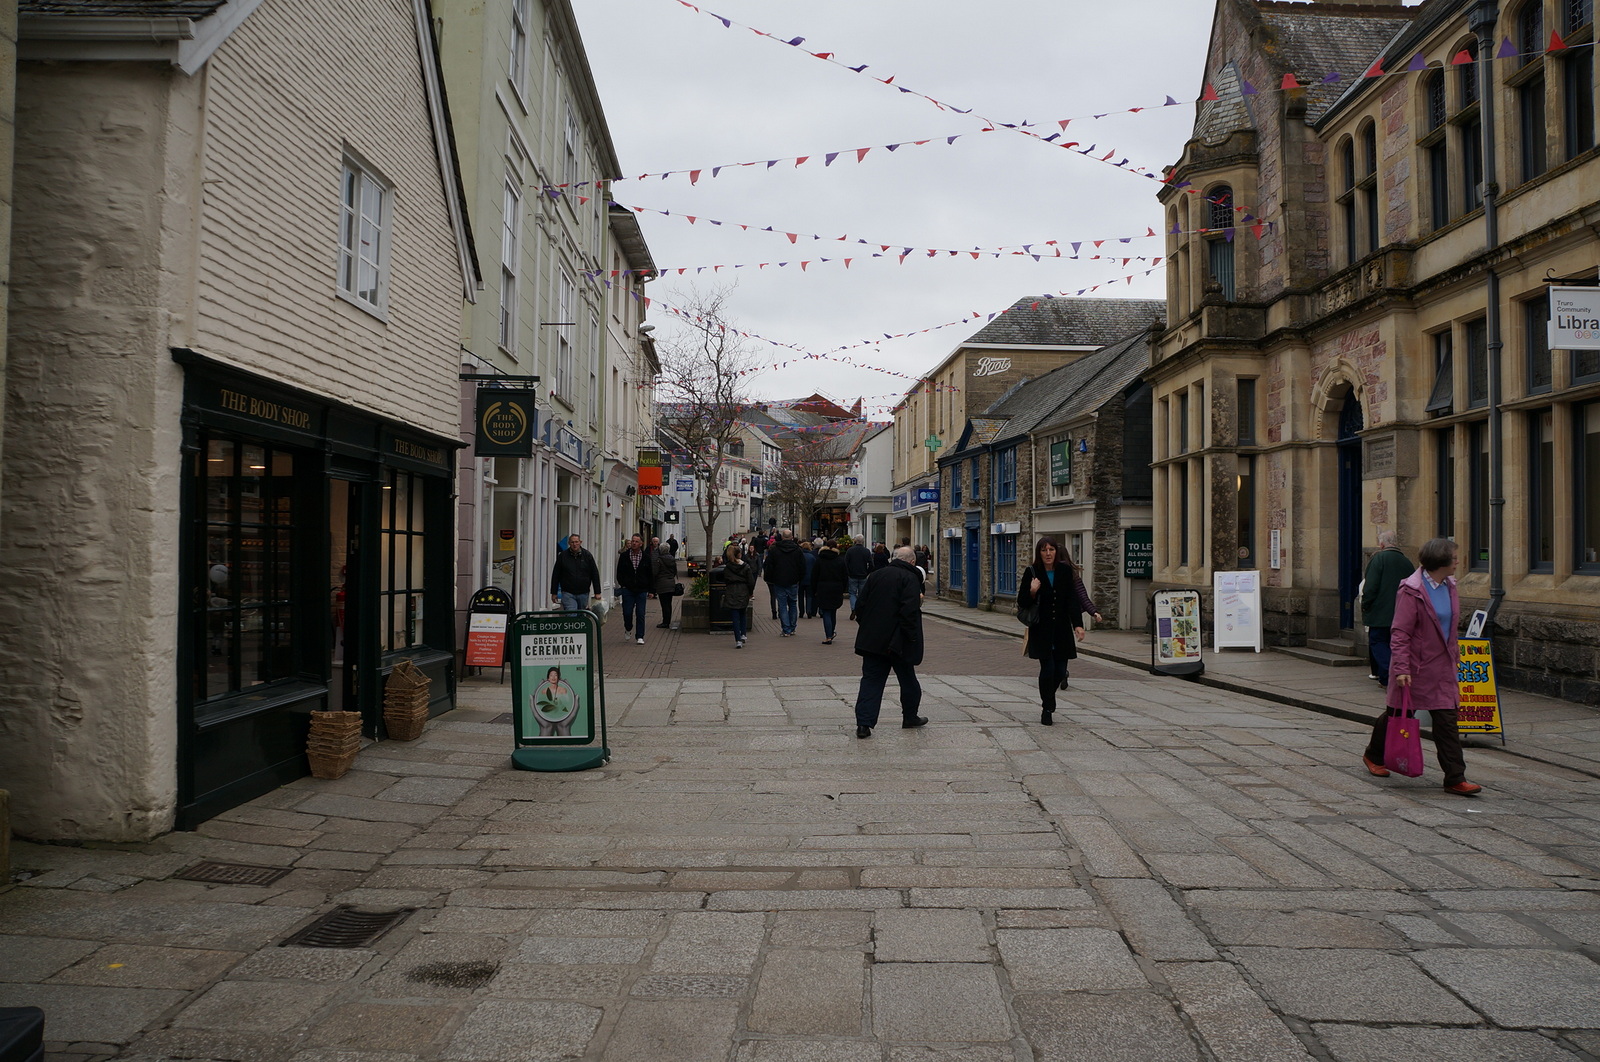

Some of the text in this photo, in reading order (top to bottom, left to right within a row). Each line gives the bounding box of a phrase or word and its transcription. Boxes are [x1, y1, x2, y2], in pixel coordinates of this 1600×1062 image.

[973, 357, 1012, 377] Boots
[220, 388, 310, 429] THE BODY SHOP
[394, 438, 410, 455] THE
[410, 443, 426, 460] BODY
[521, 623, 537, 631] THE
[539, 622, 563, 631] BODY
[534, 636, 574, 645] GREEN TEA
[525, 644, 582, 656] CEREMONY
[1467, 642, 1490, 655] around
[1457, 661, 1490, 672] NCY
[1456, 671, 1489, 683] RESS
[1462, 685, 1474, 693] off
